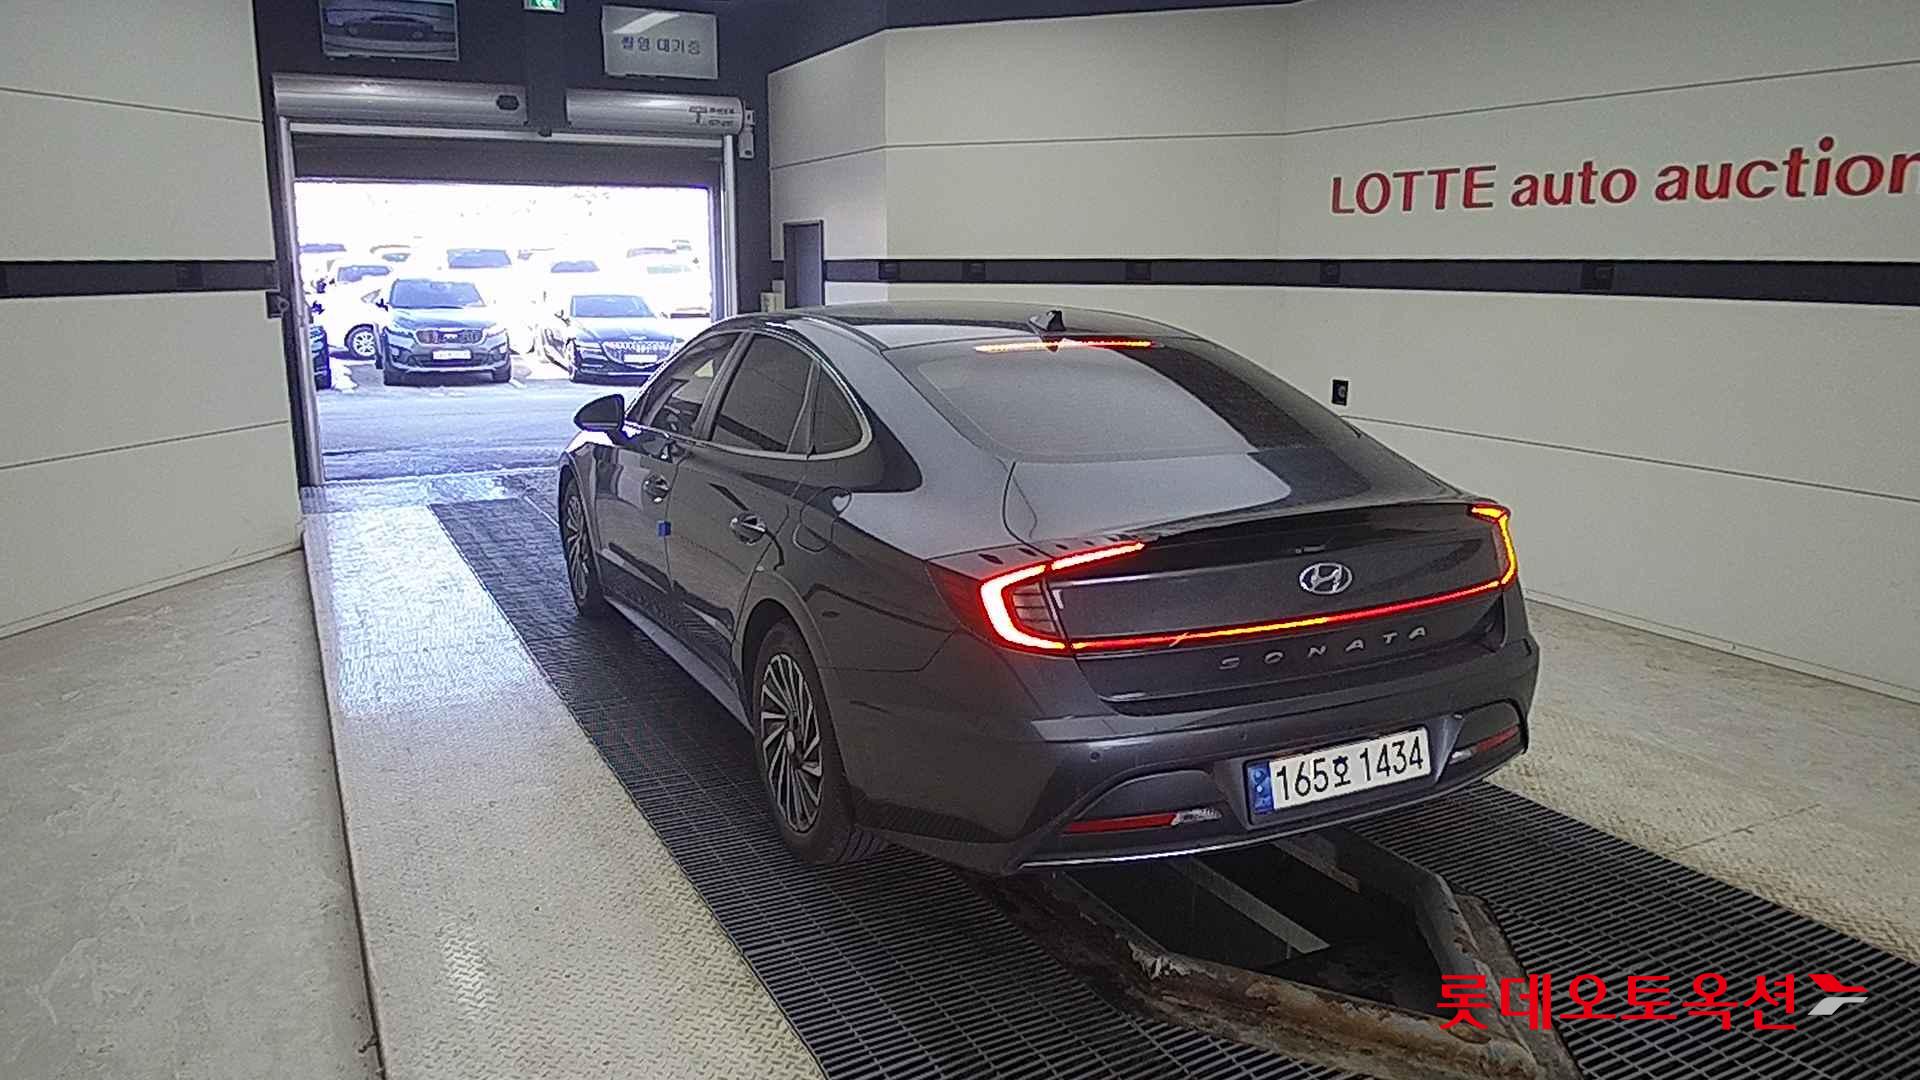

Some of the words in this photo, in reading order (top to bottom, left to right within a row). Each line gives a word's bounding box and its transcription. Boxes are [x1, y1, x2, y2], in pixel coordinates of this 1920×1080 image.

[656, 38, 701, 55] 대기중
[1331, 165, 1496, 214] LOTTE
[1511, 161, 1637, 206] auto
[1218, 626, 1427, 671] SONATA
[1276, 755, 1351, 801] 165호
[1359, 735, 1424, 782] 1434
